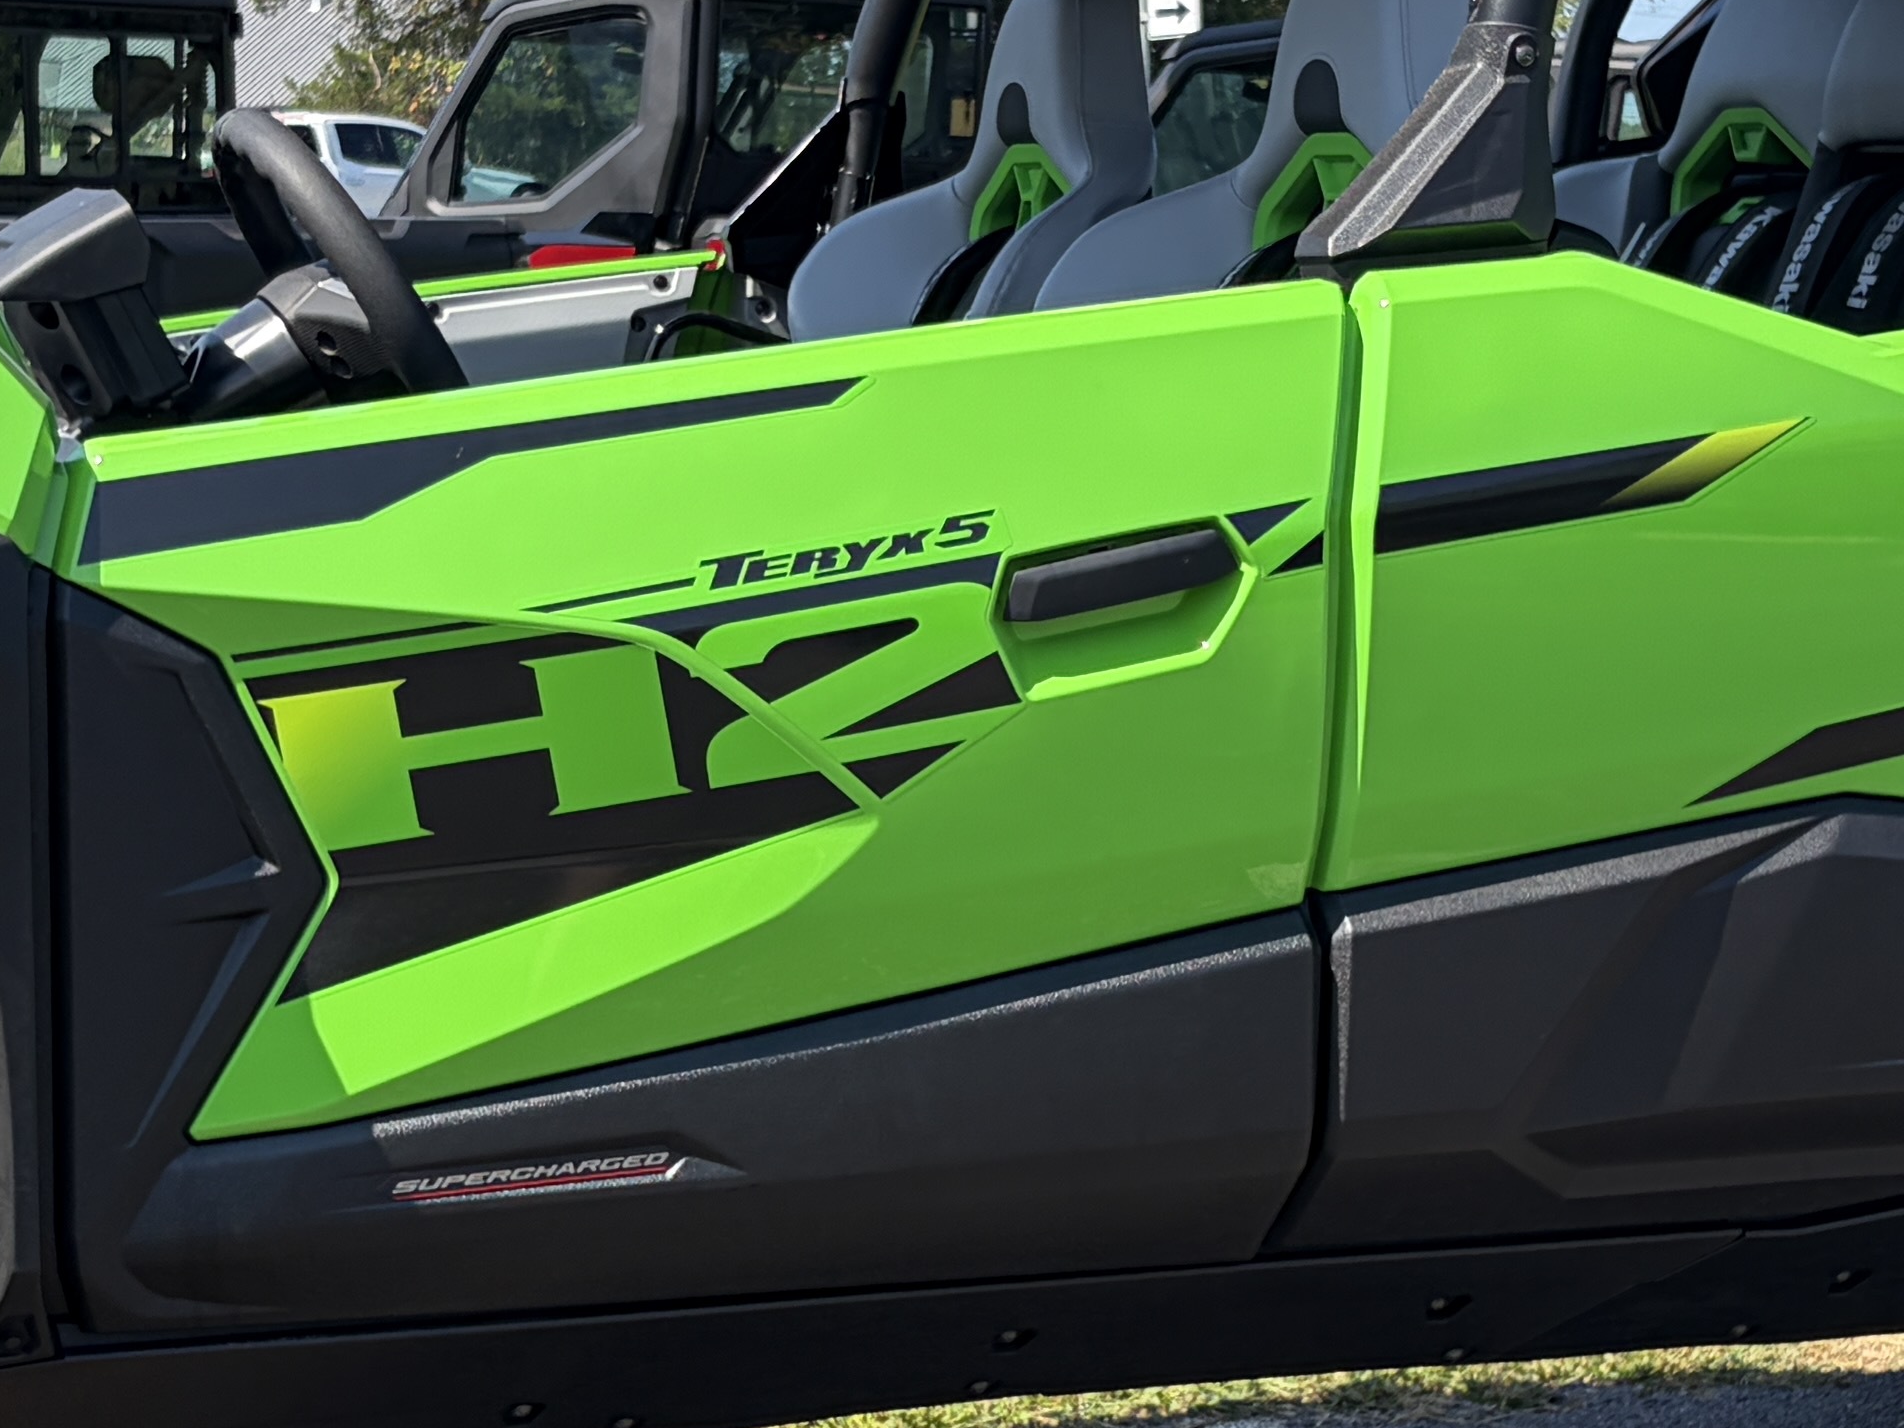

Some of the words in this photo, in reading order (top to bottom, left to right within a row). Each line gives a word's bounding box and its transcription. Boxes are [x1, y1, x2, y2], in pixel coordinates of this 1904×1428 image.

[1702, 206, 1783, 291] Kawa
[256, 582, 1024, 855] H2
[392, 1151, 671, 1195] SUPERCHARGED
